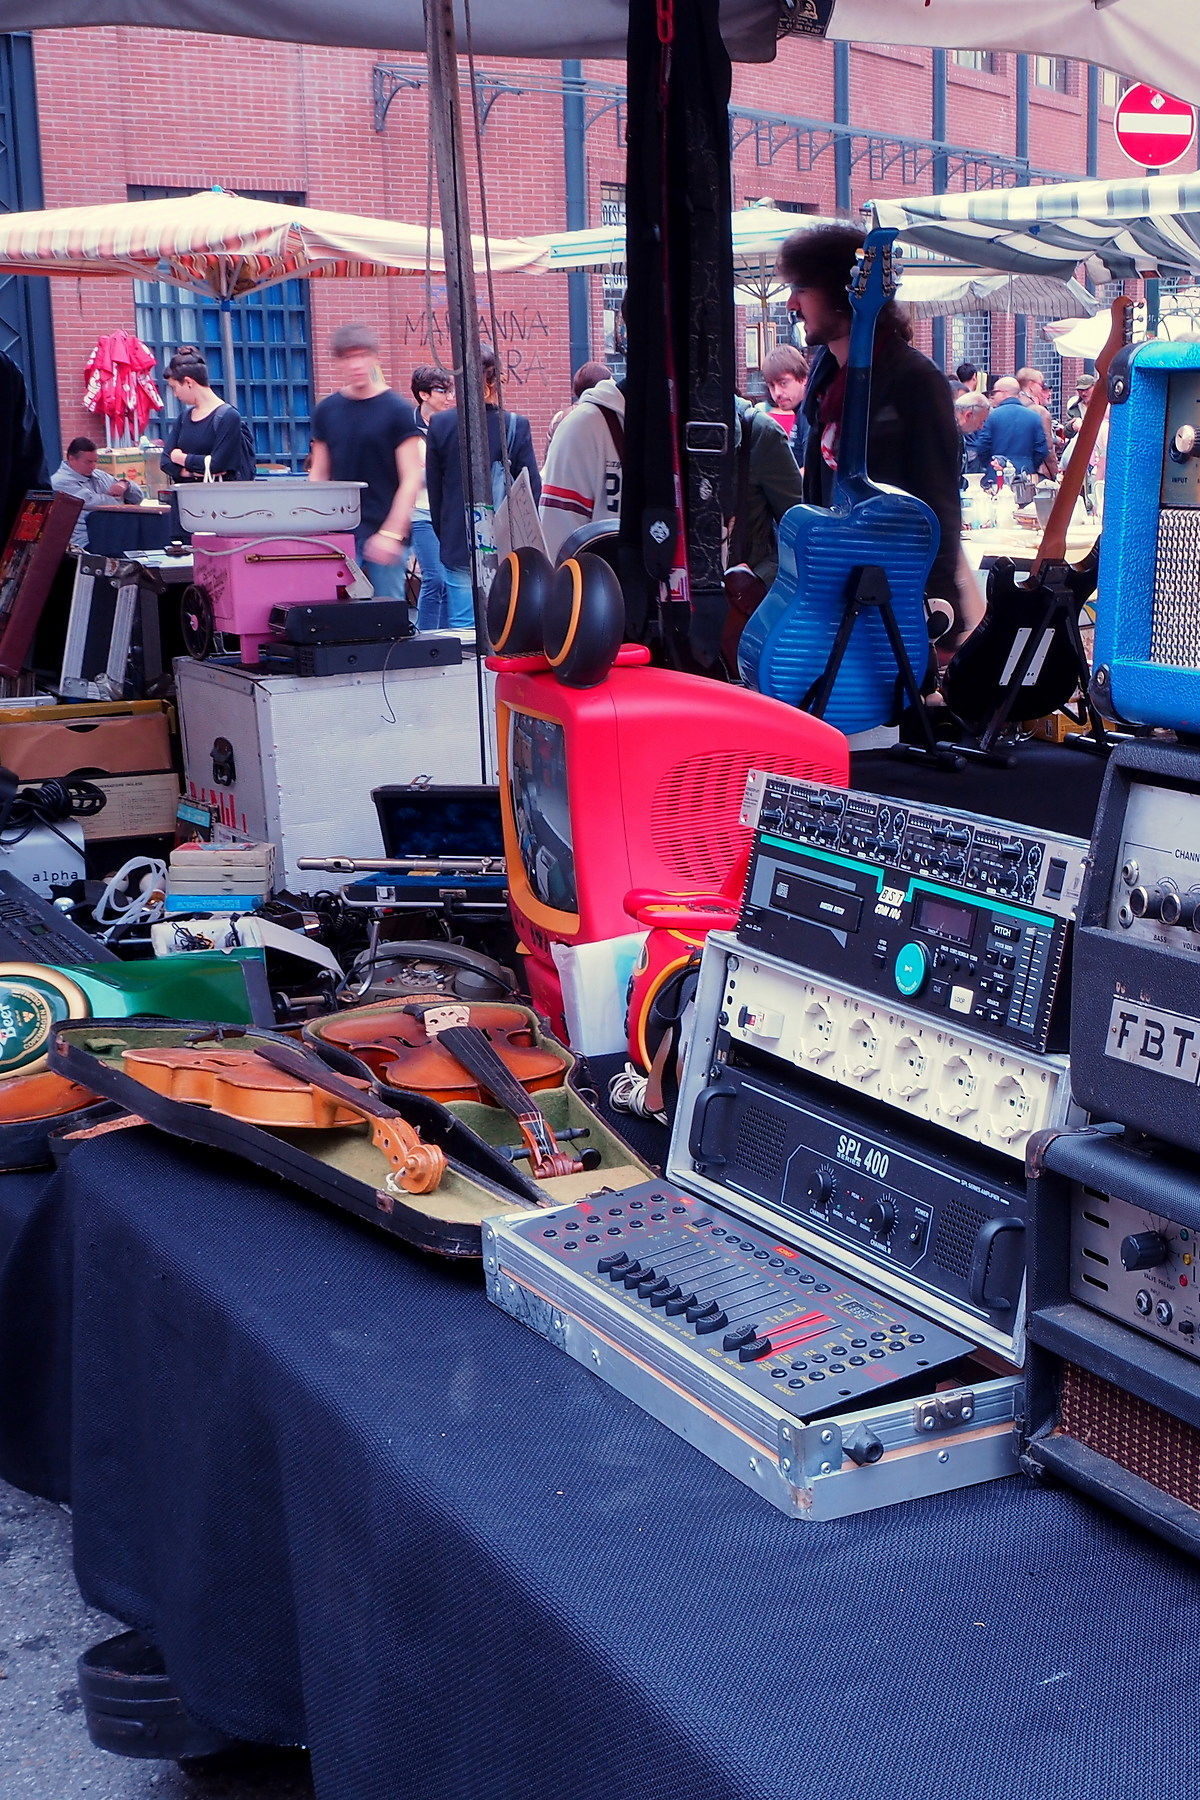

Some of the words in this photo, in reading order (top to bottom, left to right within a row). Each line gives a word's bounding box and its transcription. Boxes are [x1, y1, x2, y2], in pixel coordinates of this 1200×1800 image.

[404, 307, 549, 346] MAANNA
[32, 870, 79, 884] alpha
[881, 889, 903, 904] BST
[993, 925, 1011, 937] PITCH
[1153, 934, 1168, 944] BASS
[1117, 1011, 1195, 1068] FBT
[836, 1152, 861, 1168] SERIES
[837, 1134, 862, 1163] SPL
[864, 1147, 890, 1179] 400
[914, 1207, 930, 1218] POWER
[870, 1239, 886, 1253] CHANNEL
